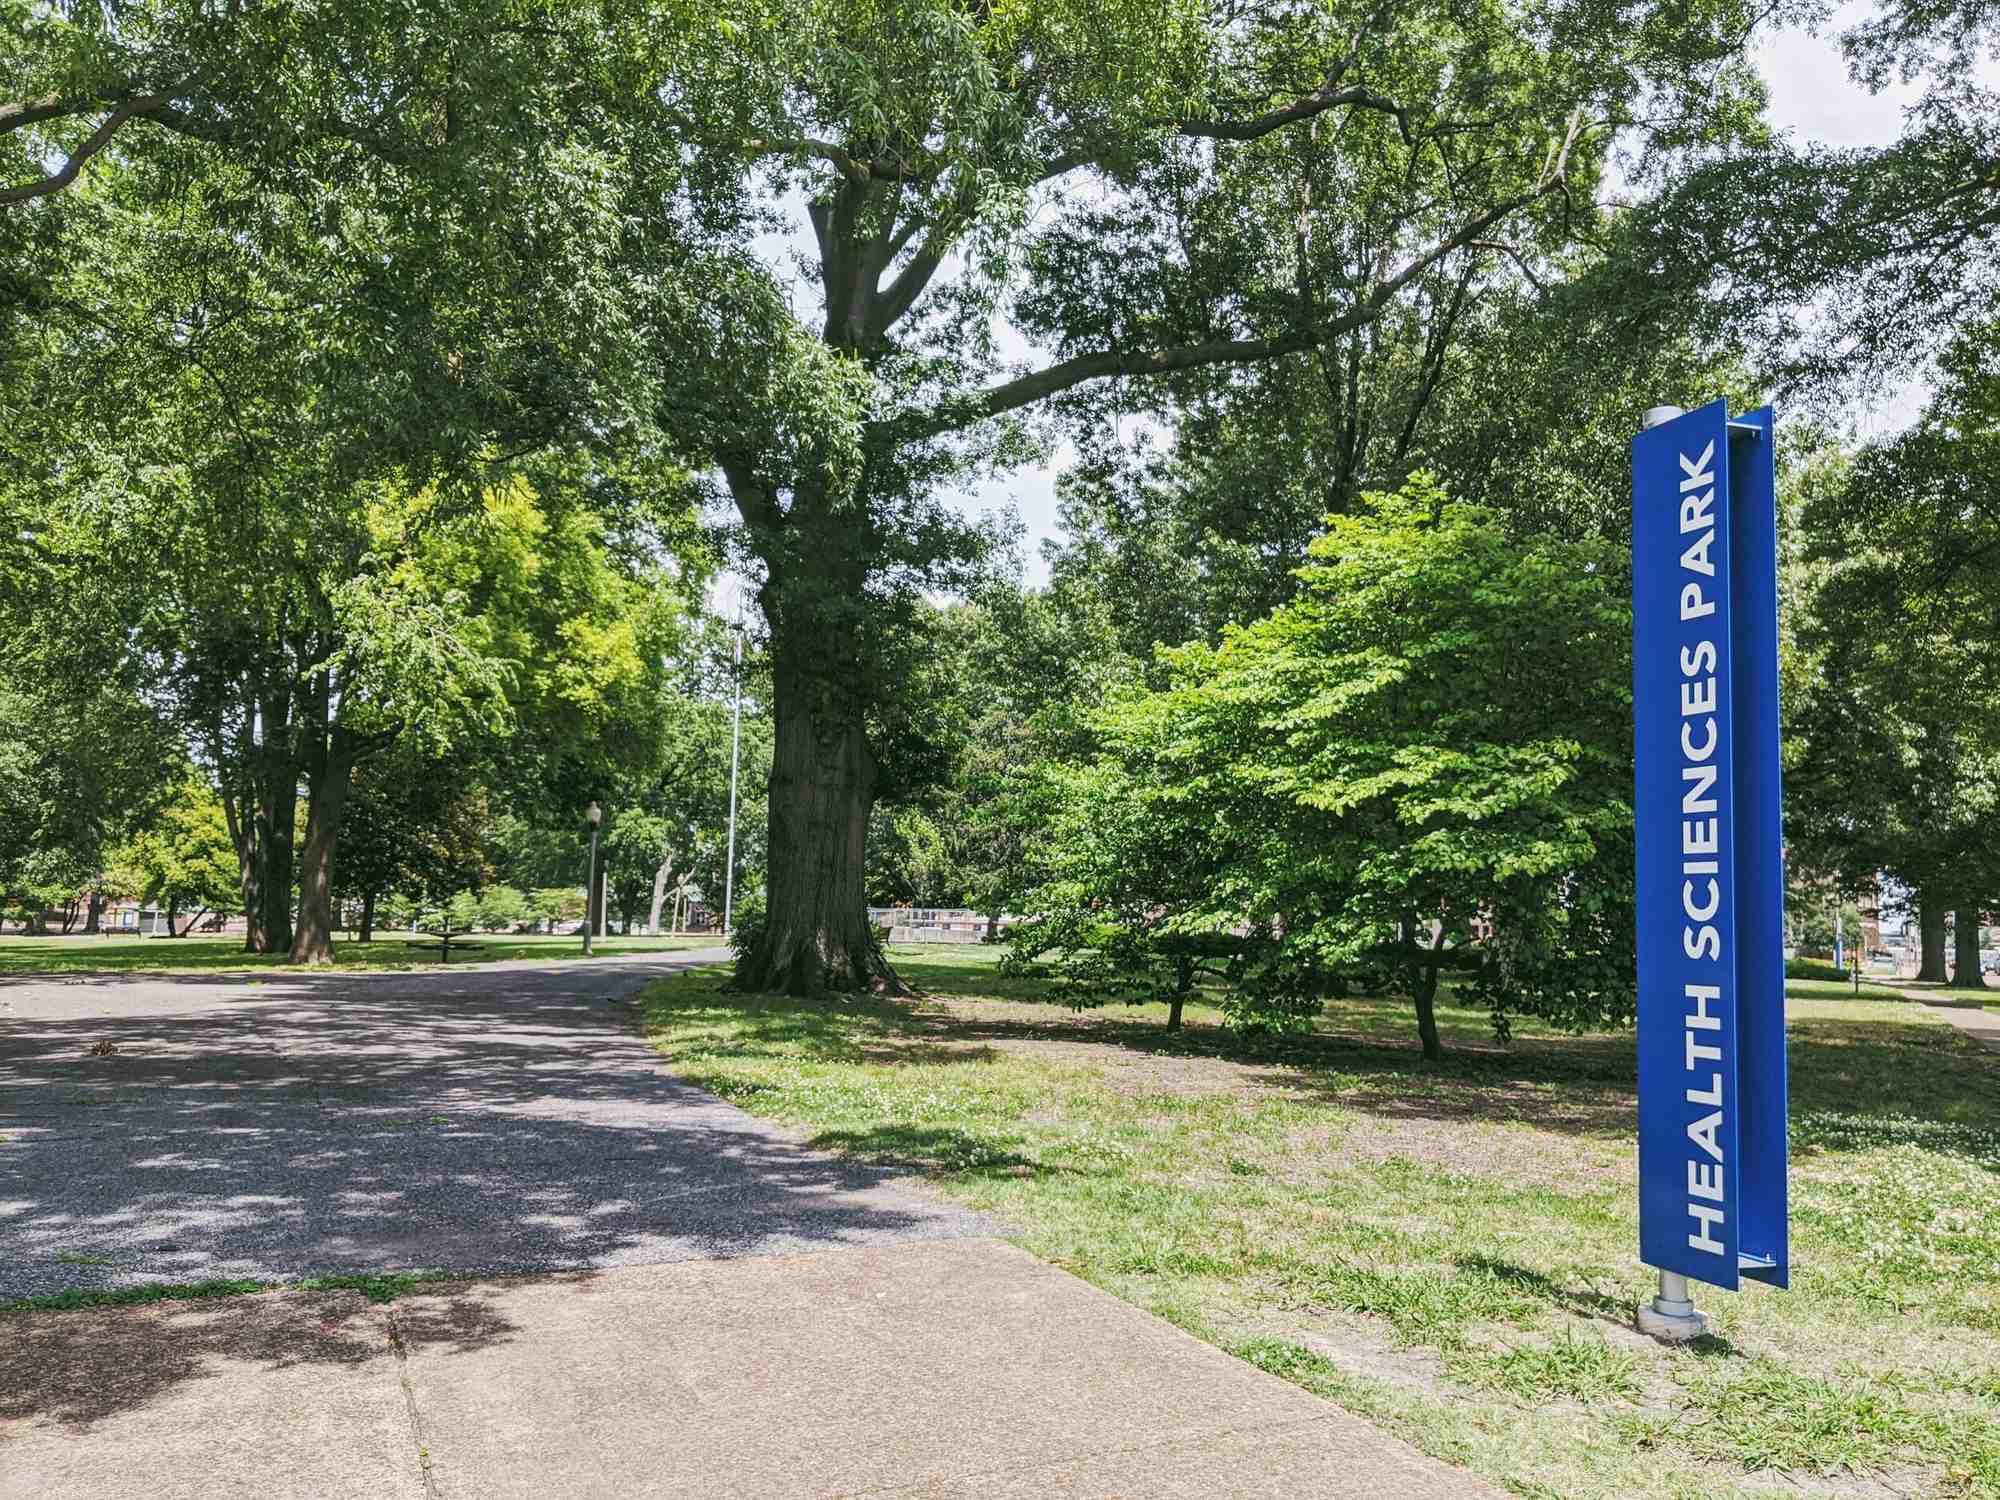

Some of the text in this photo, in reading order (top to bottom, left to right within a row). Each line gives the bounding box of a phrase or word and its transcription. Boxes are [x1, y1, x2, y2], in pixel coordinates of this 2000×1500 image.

[1679, 439, 1724, 1256] HEALTH SCIENCES PARK
